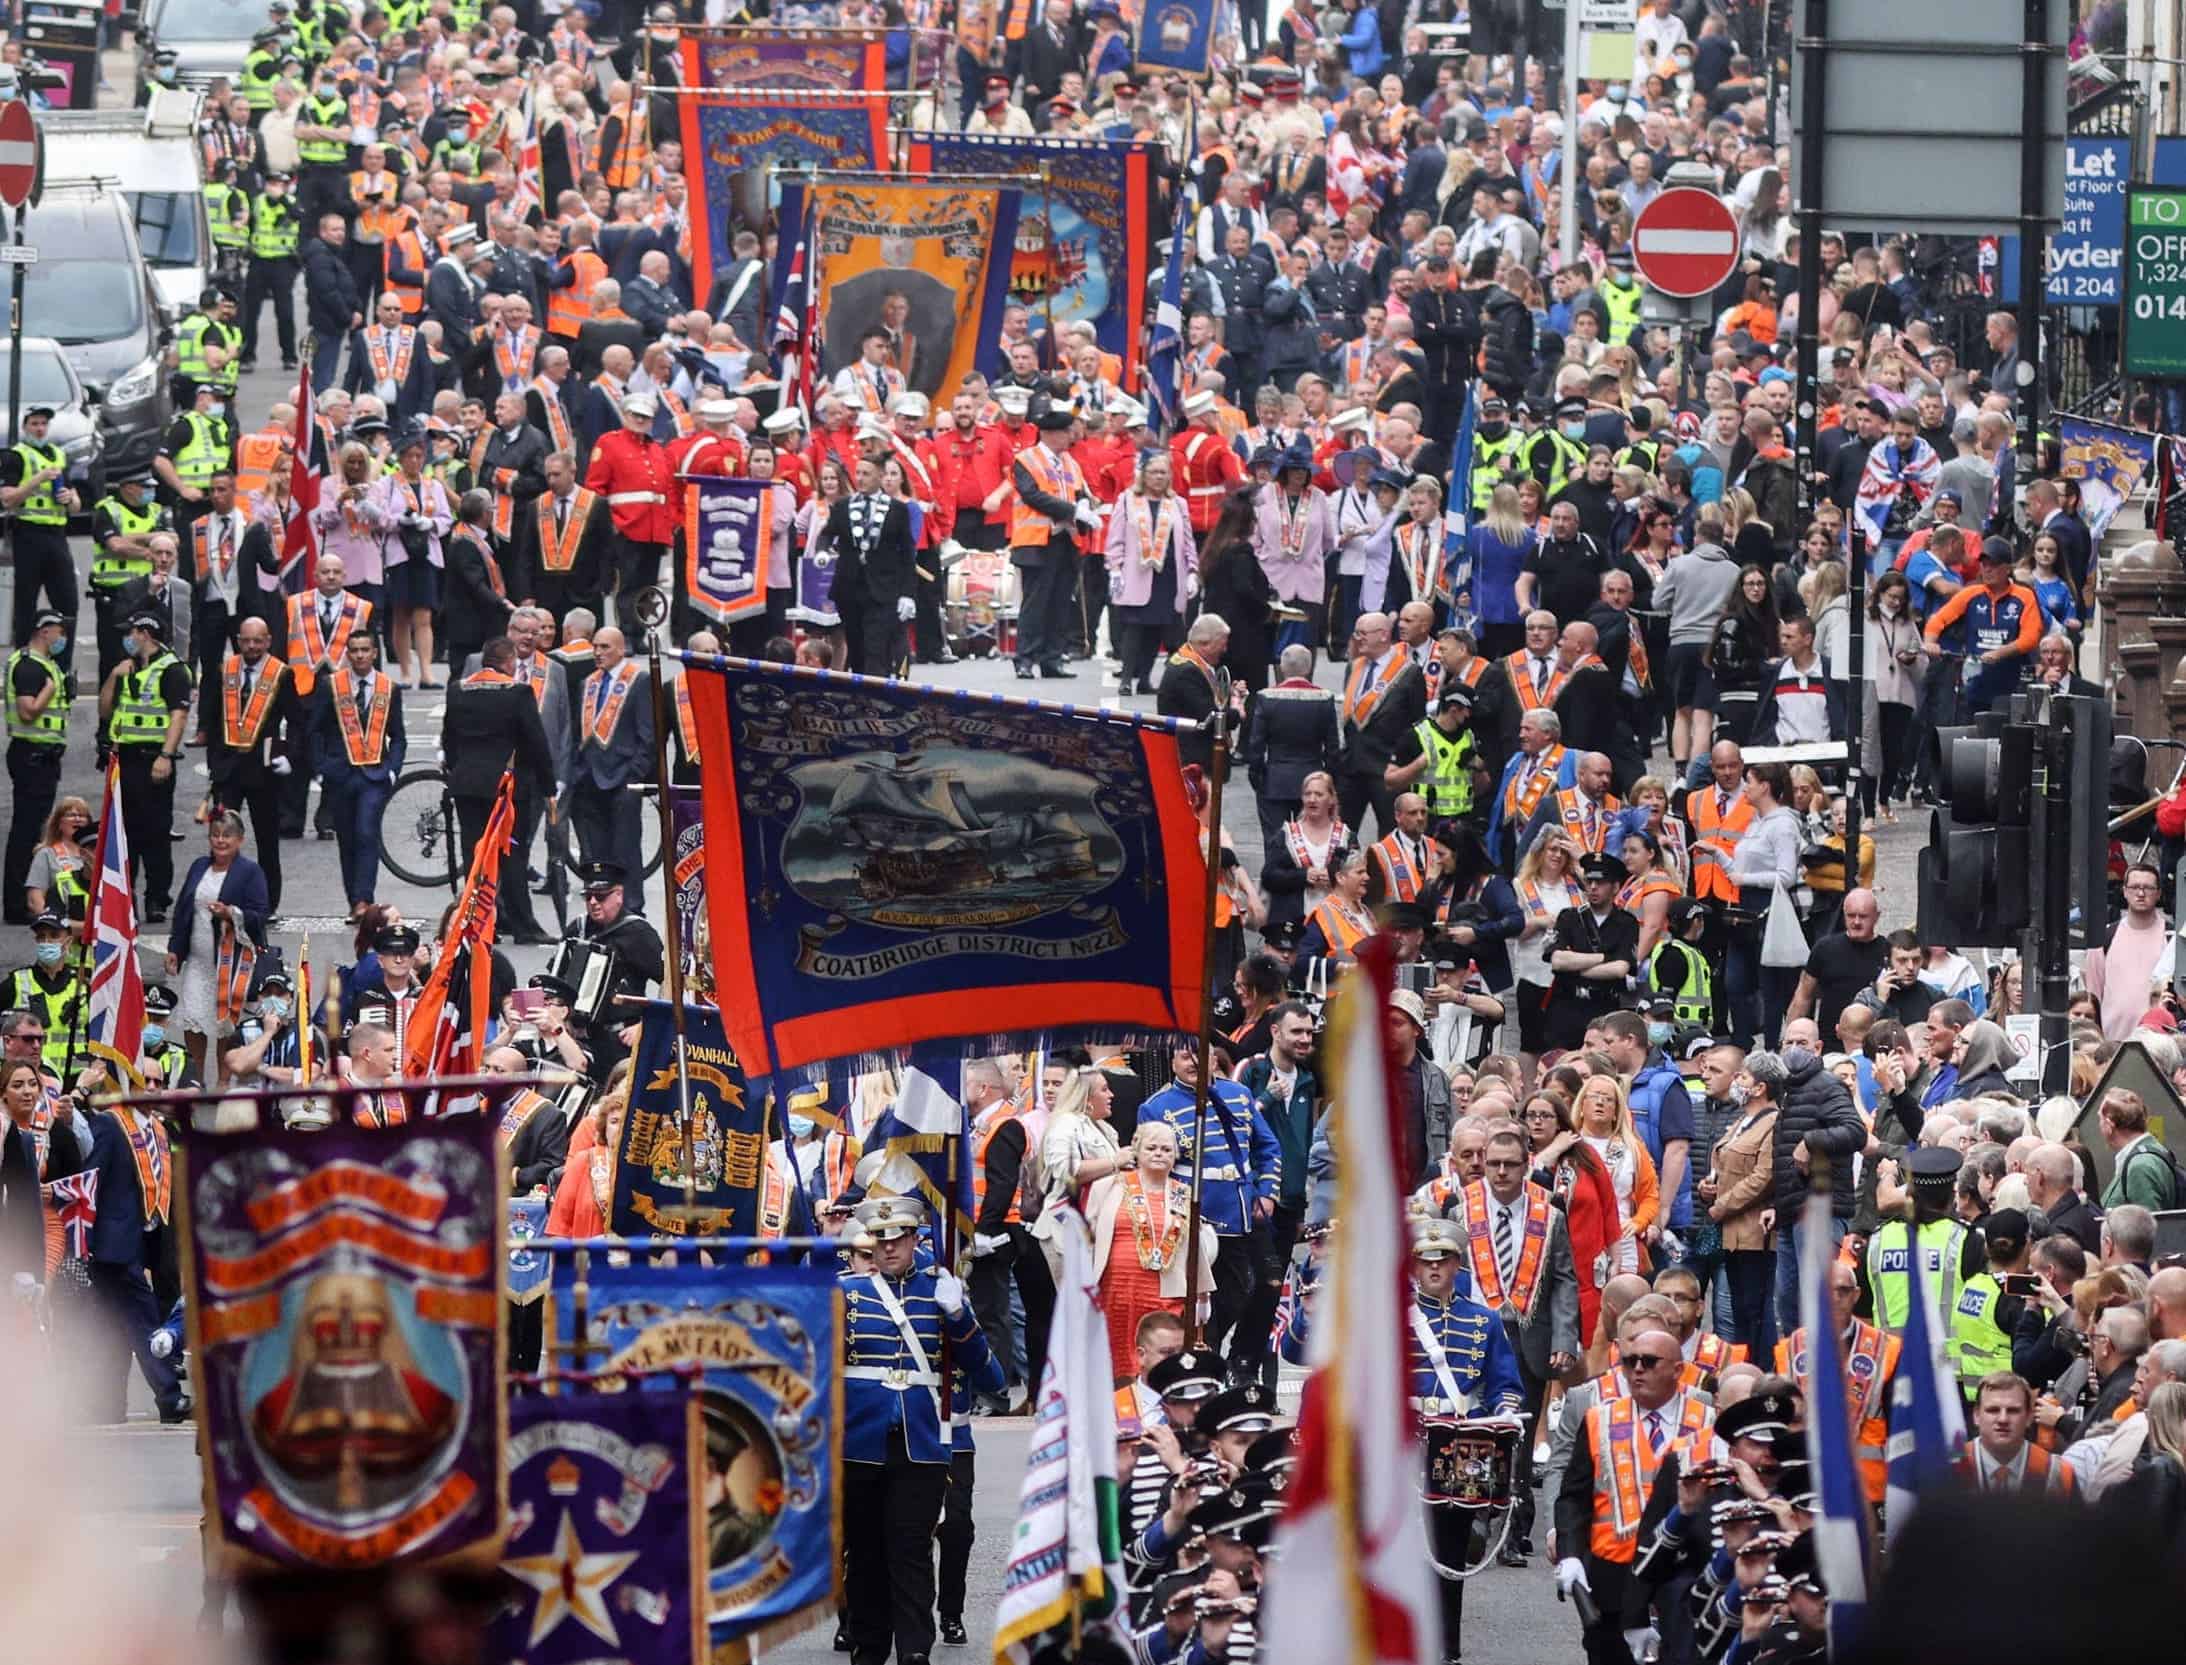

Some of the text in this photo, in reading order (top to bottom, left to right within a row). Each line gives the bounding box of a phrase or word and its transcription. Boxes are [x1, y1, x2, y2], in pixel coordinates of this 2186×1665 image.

[2066, 147, 2116, 177] Let
[2080, 181, 2114, 194] Floor
[2139, 198, 2180, 223] TO
[2081, 217, 2092, 232] ft
[2075, 277, 2115, 296] 204
[2134, 295, 2186, 319] 014
[813, 940, 949, 977] COATBRIDGE
[957, 934, 1060, 958] DISTRICT
